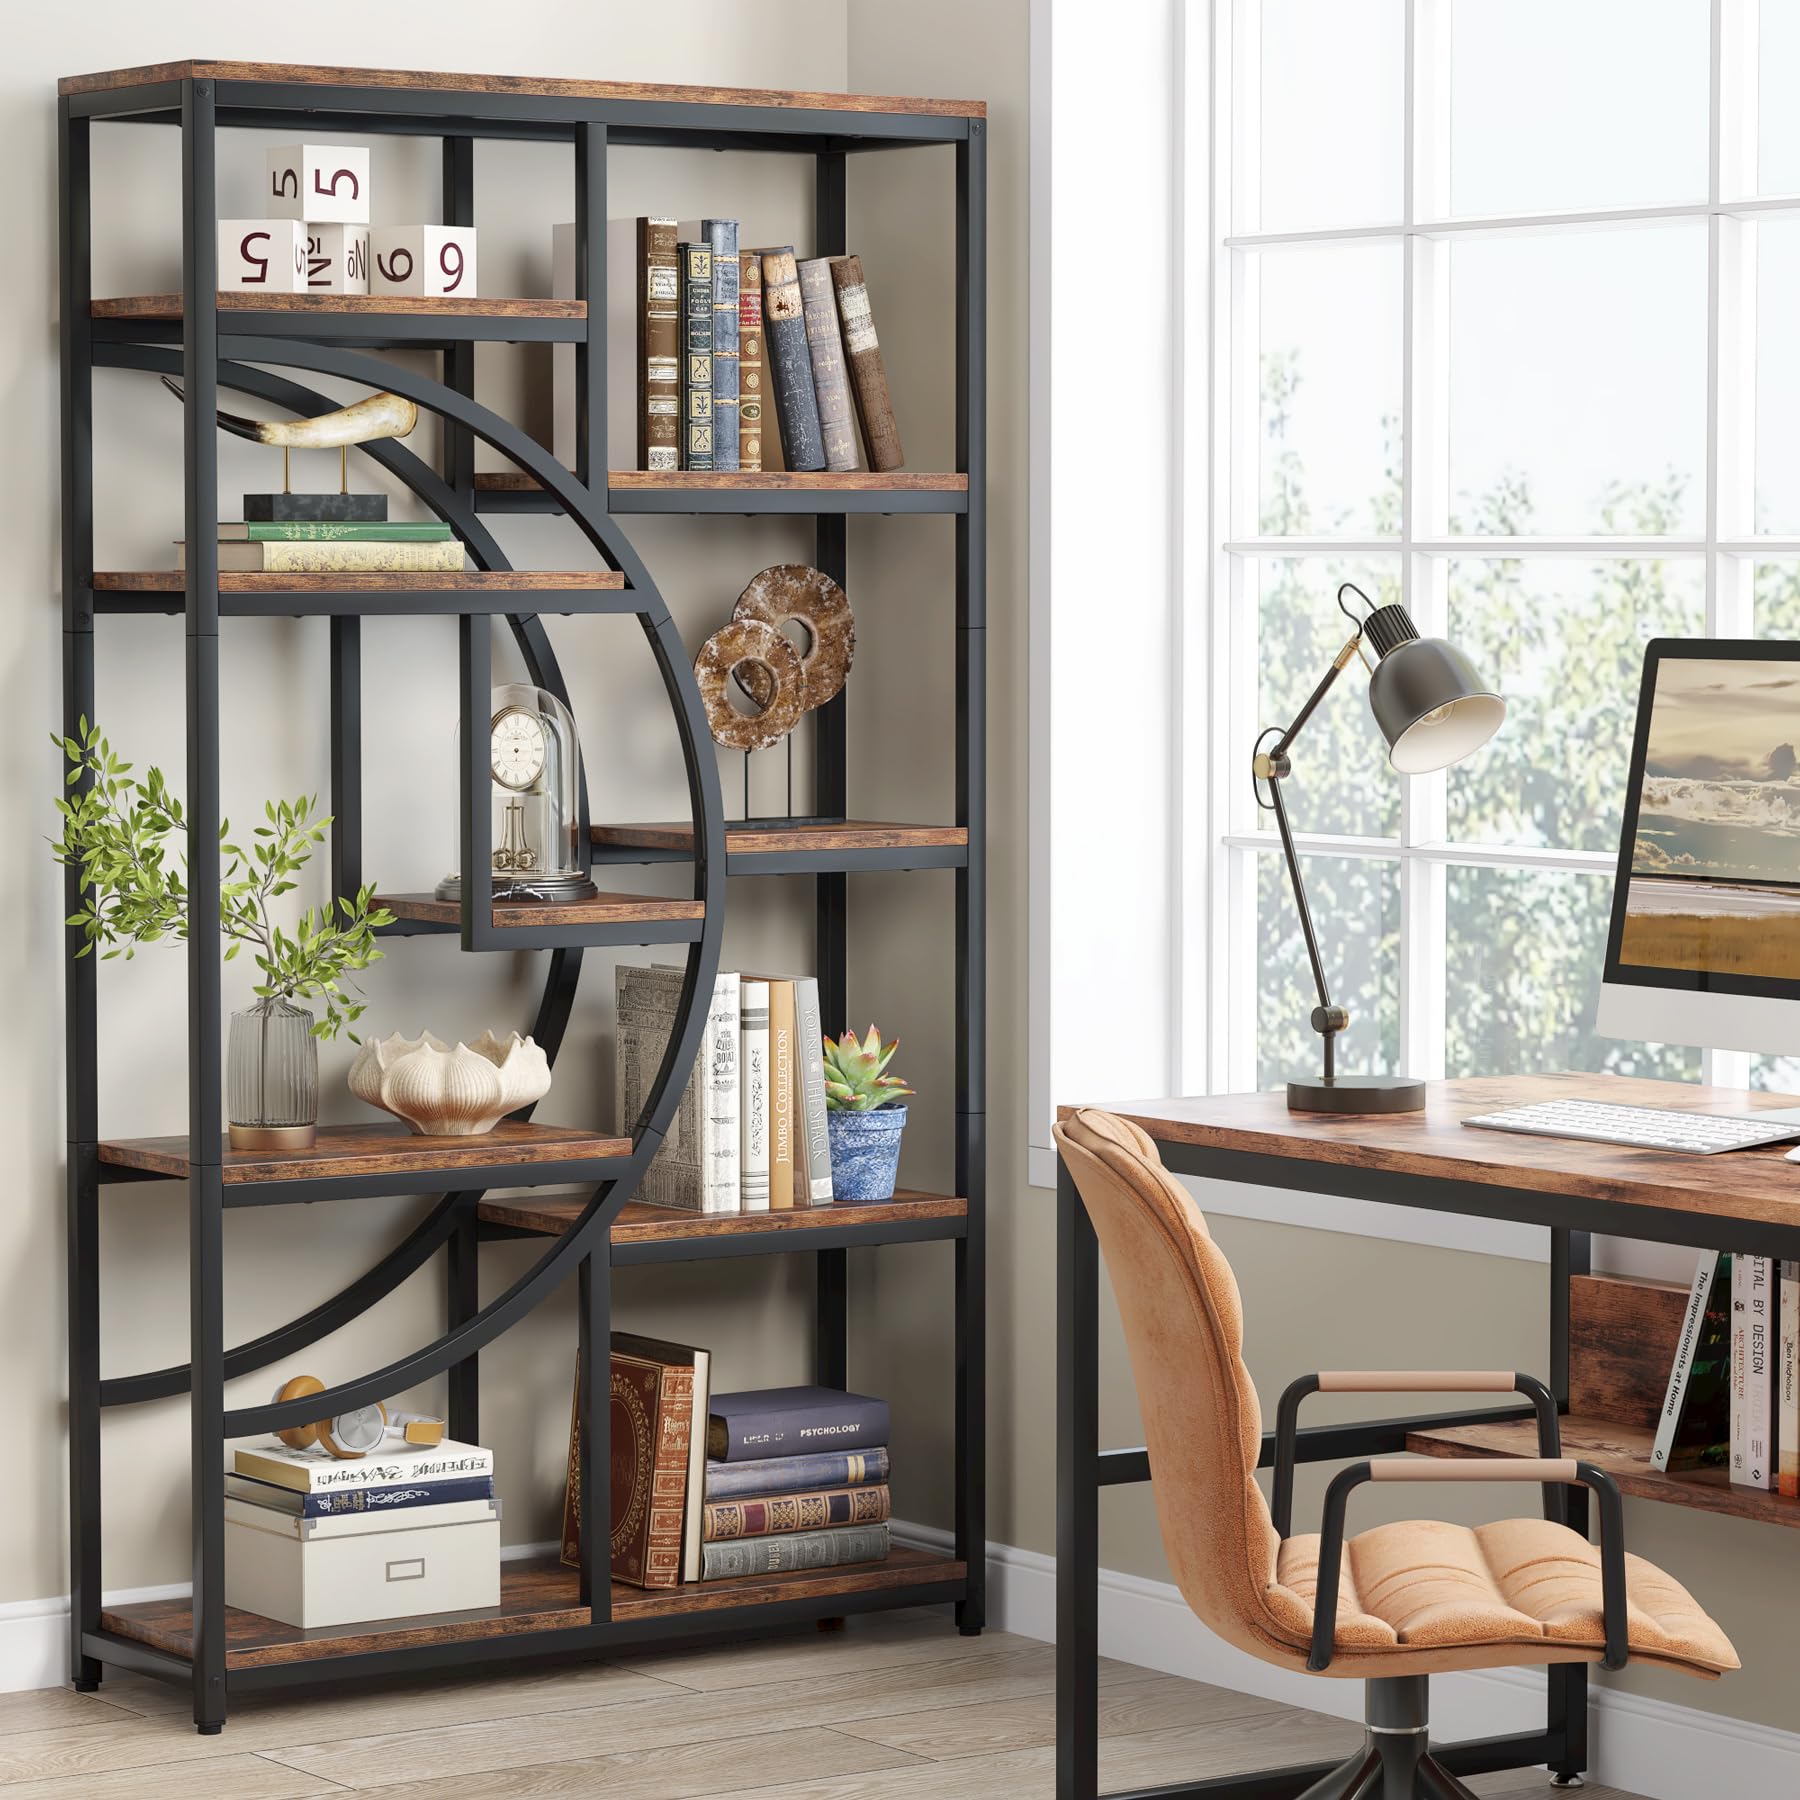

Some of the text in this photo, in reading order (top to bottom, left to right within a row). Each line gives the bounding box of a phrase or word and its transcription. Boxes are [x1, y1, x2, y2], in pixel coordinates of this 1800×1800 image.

[315, 168, 359, 200] 5
[804, 1006, 819, 1061] YOUNG
[807, 1078, 827, 1161] THE SHACK
[1753, 1299, 1765, 1316] BY
[1666, 1271, 1709, 1417] The Impressionists at Home
[1752, 1324, 1765, 1375] DESIGN
[1785, 1342, 1794, 1401] Ben Nicholson
[800, 1423, 861, 1437] PSYCHOLOGY
